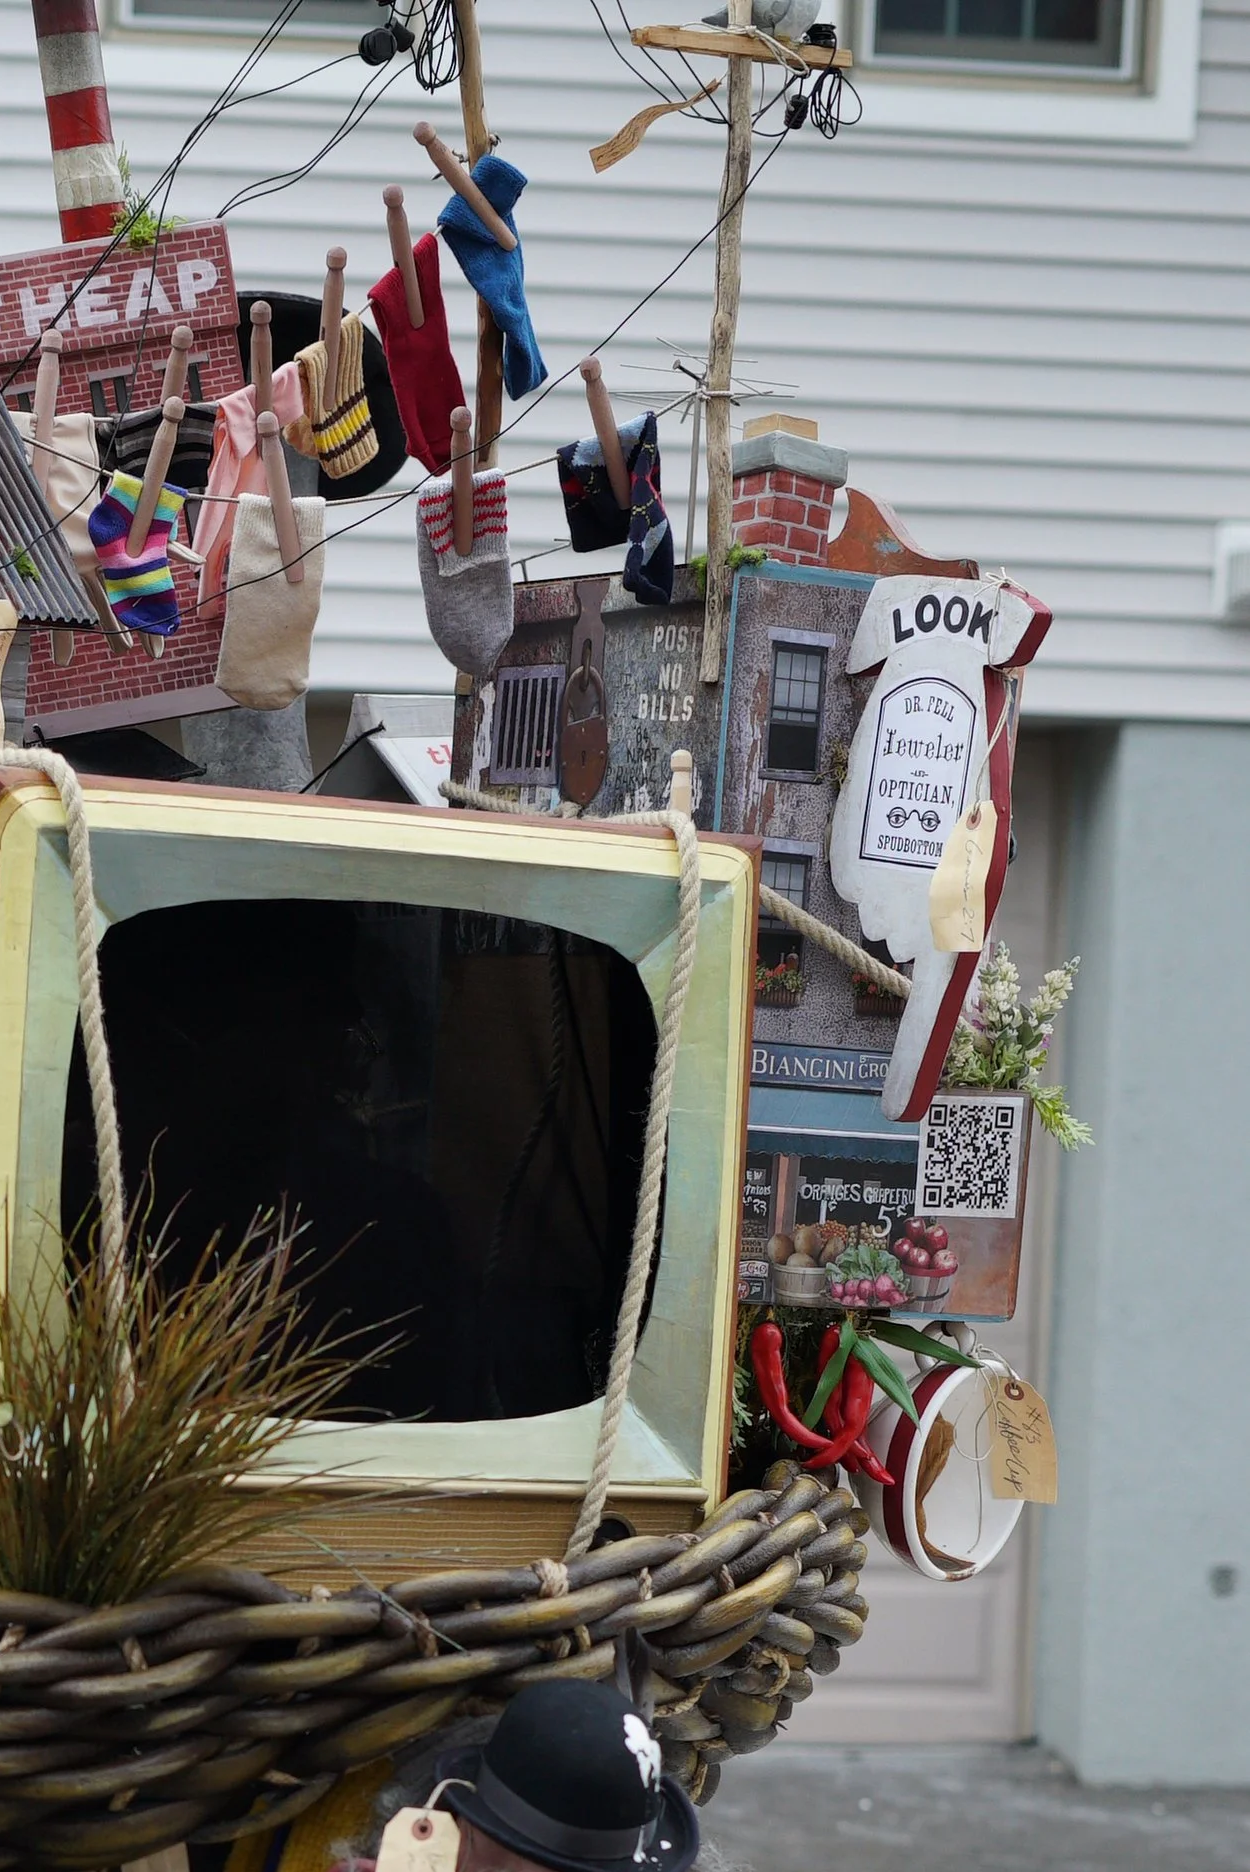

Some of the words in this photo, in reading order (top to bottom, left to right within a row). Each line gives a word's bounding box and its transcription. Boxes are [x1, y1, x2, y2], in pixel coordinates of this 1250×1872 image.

[19, 259, 217, 337] HEAP
[892, 594, 998, 643] LOOK
[652, 624, 702, 653] POST
[658, 662, 683, 690] NO
[638, 693, 694, 721] BILLS
[904, 695, 924, 715] DR.
[927, 695, 955, 723] FELL
[882, 728, 964, 765] Jeweler
[879, 779, 955, 808] OPTICIAN,
[877, 834, 944, 858] SPUDBOTTOM
[801, 1183, 861, 1202] ORANGES
